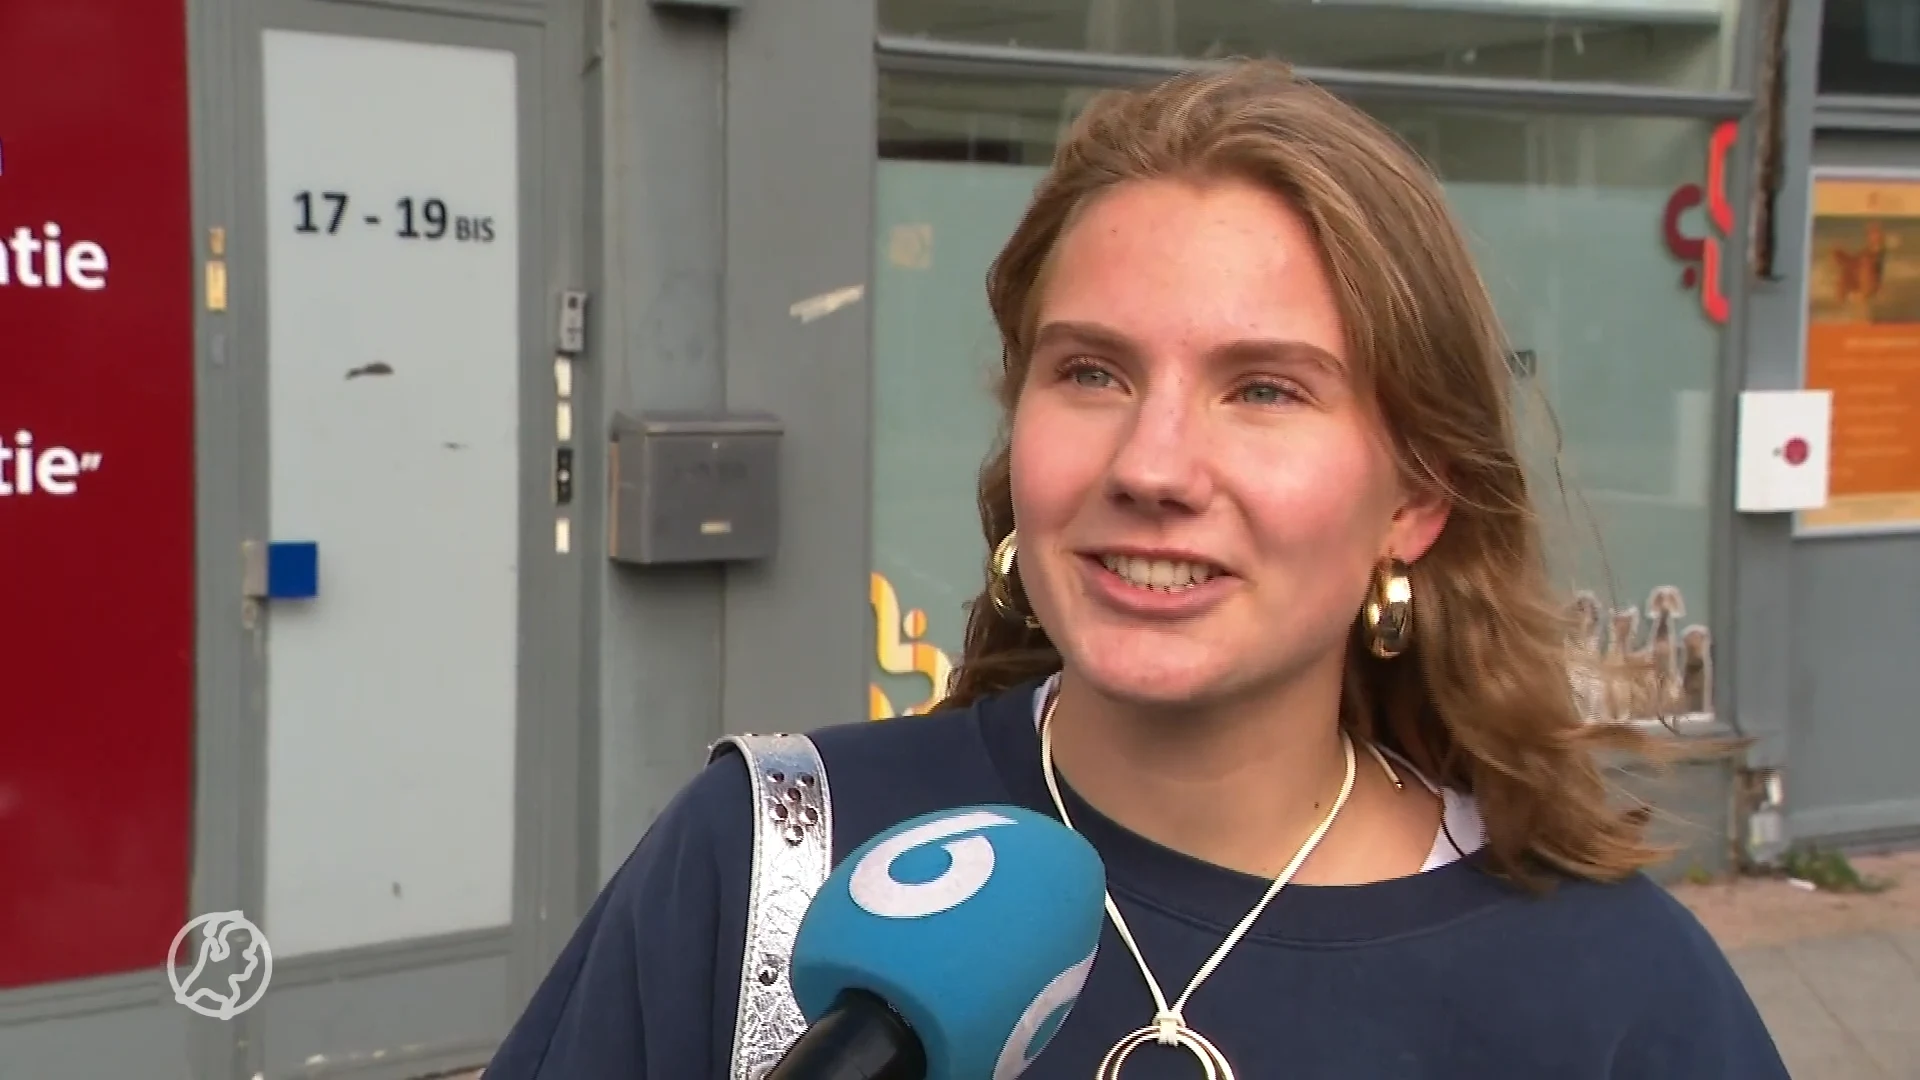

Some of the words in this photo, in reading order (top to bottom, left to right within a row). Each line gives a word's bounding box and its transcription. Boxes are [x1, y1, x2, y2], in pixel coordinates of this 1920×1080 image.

[294, 190, 349, 235] 17
[363, 215, 380, 225] -
[396, 196, 447, 240] 19
[455, 216, 495, 241] BIS
[0, 221, 109, 290] tie
